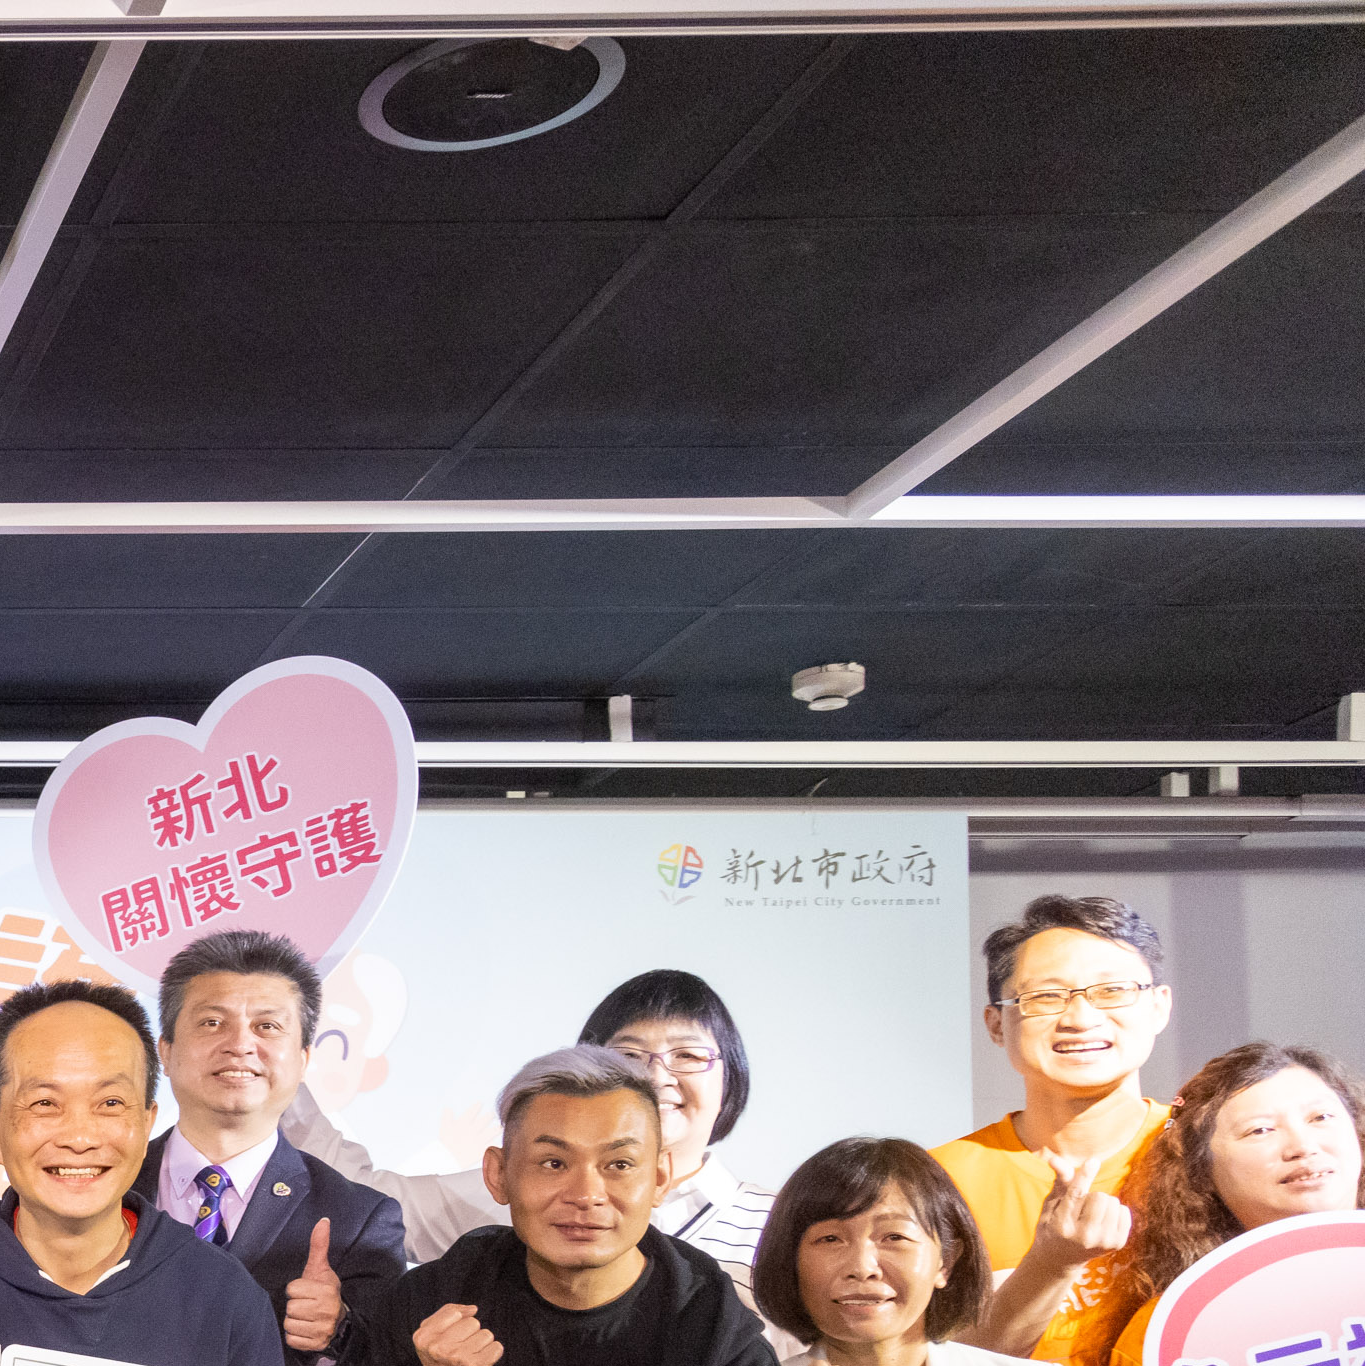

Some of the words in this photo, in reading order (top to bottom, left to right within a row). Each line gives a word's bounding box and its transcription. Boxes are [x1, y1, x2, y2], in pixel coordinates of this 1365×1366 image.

[147, 754, 290, 848] 新北
[101, 801, 383, 952] 關懷守護
[720, 845, 936, 891] 新北市政府
[725, 897, 755, 907] New
[762, 897, 808, 909] Taipei
[814, 896, 844, 909] City
[851, 896, 941, 907] Government
